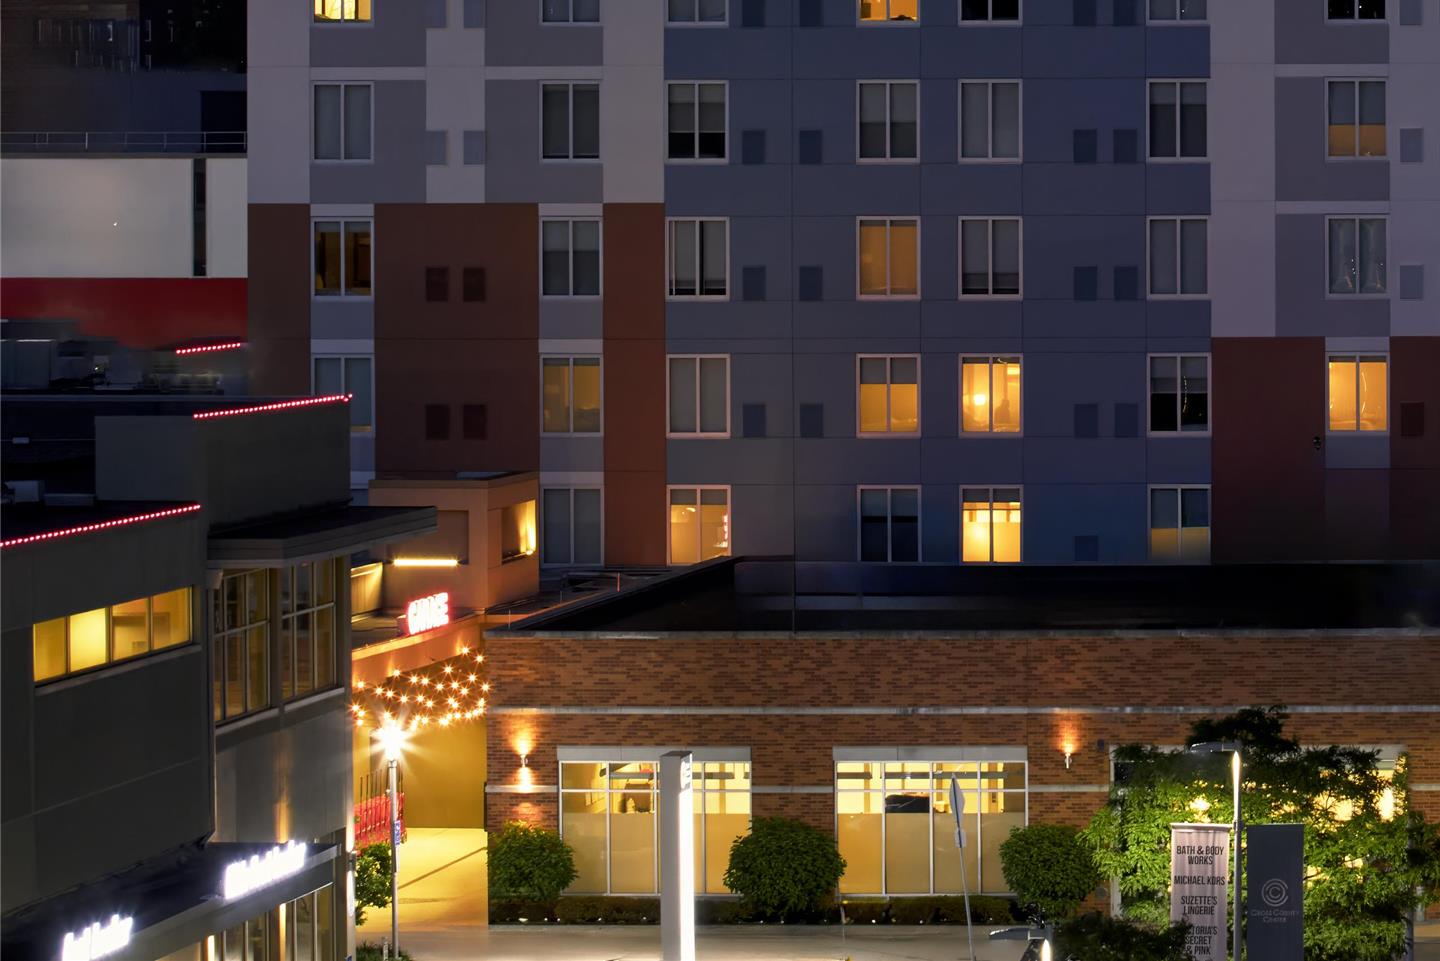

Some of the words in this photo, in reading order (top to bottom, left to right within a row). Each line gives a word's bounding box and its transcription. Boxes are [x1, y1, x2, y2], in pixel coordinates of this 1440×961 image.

[1176, 845, 1195, 855] BATH
[1197, 845, 1204, 855] &
[1205, 845, 1224, 856] BODY
[1188, 855, 1213, 865] WORKS
[1174, 875, 1205, 886] MICHAEL
[1207, 876, 1226, 886] KORS
[1181, 896, 1217, 906] SUZETTE'S
[1183, 906, 1215, 916] LINGERIE
[1194, 945, 1211, 955] PINK
